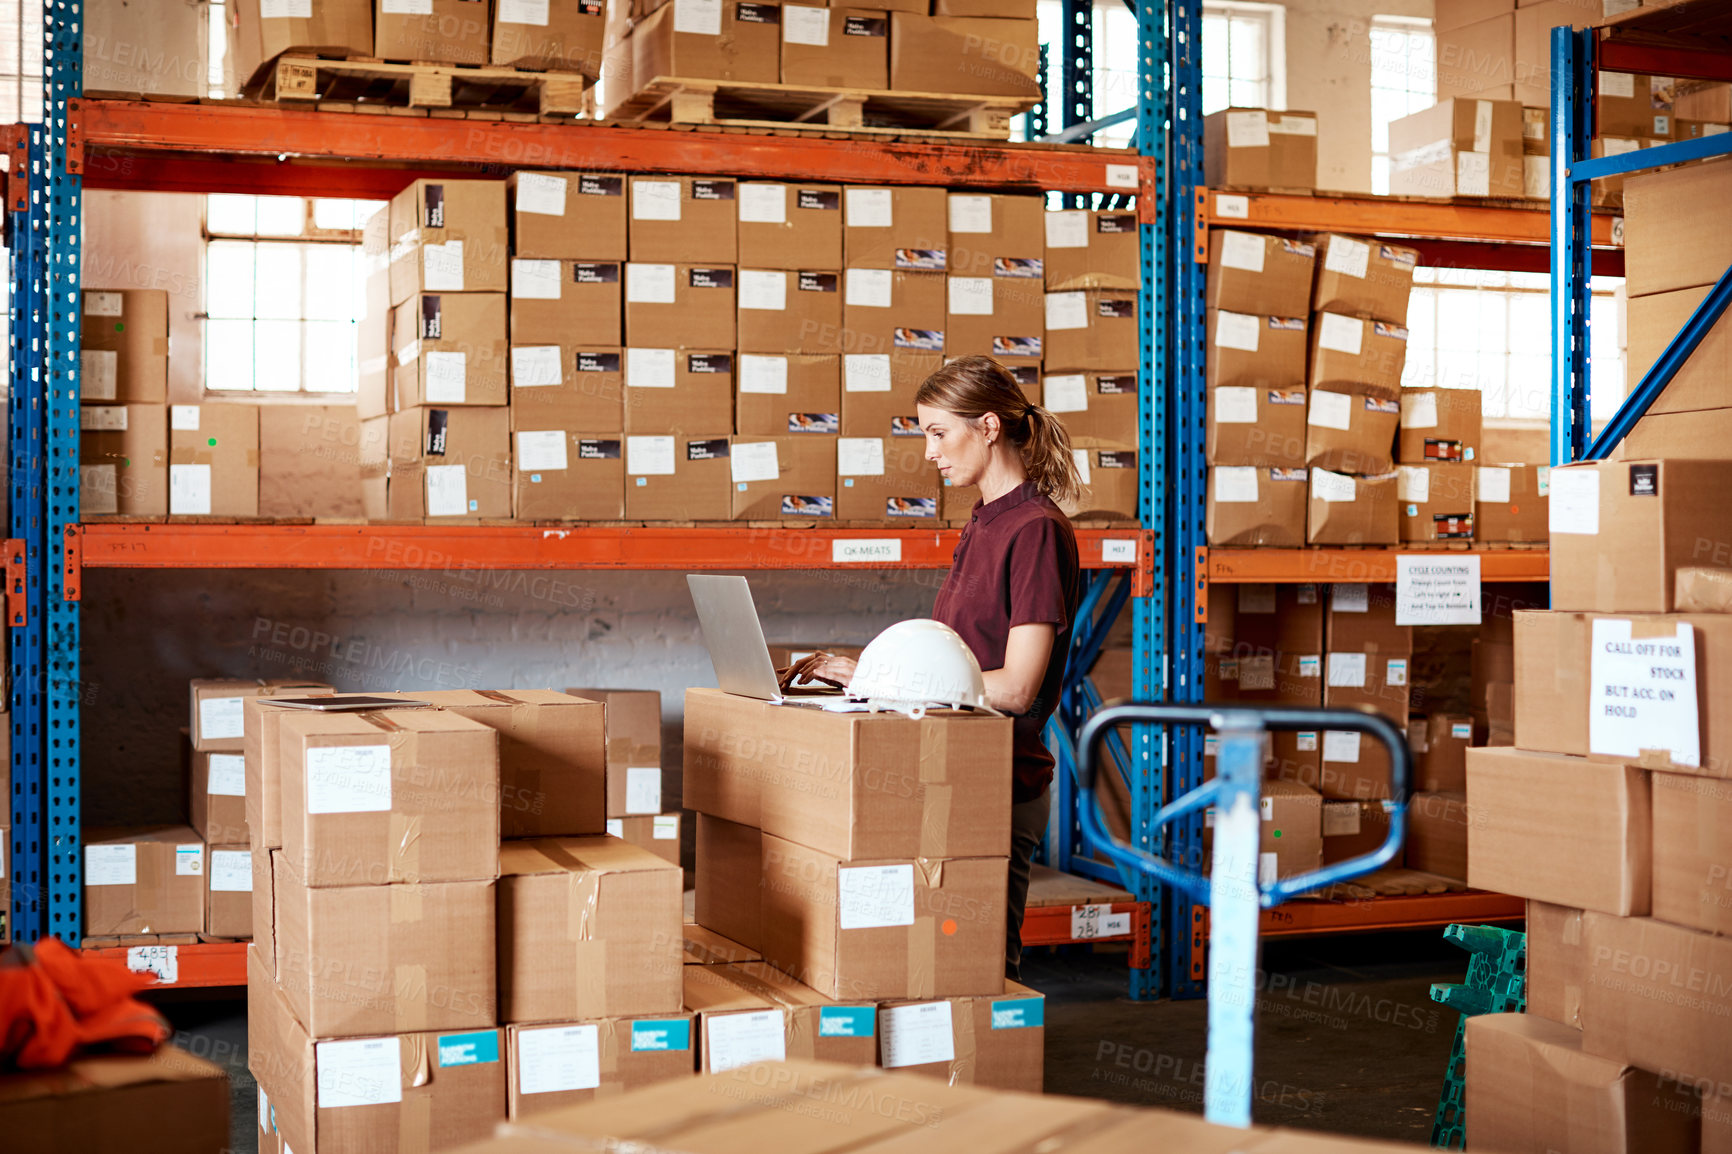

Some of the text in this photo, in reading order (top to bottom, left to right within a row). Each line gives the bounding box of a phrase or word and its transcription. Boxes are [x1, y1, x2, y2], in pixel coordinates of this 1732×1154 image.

[1408, 567, 1470, 575] CYCLE COUNTING
[1605, 642, 1682, 658] CALL OFF FOR
[1650, 667, 1686, 680] STOCK
[1605, 685, 1676, 701] BUT ACC. ON
[1605, 705, 1637, 718] HOLD
[136, 947, 168, 960] 485
